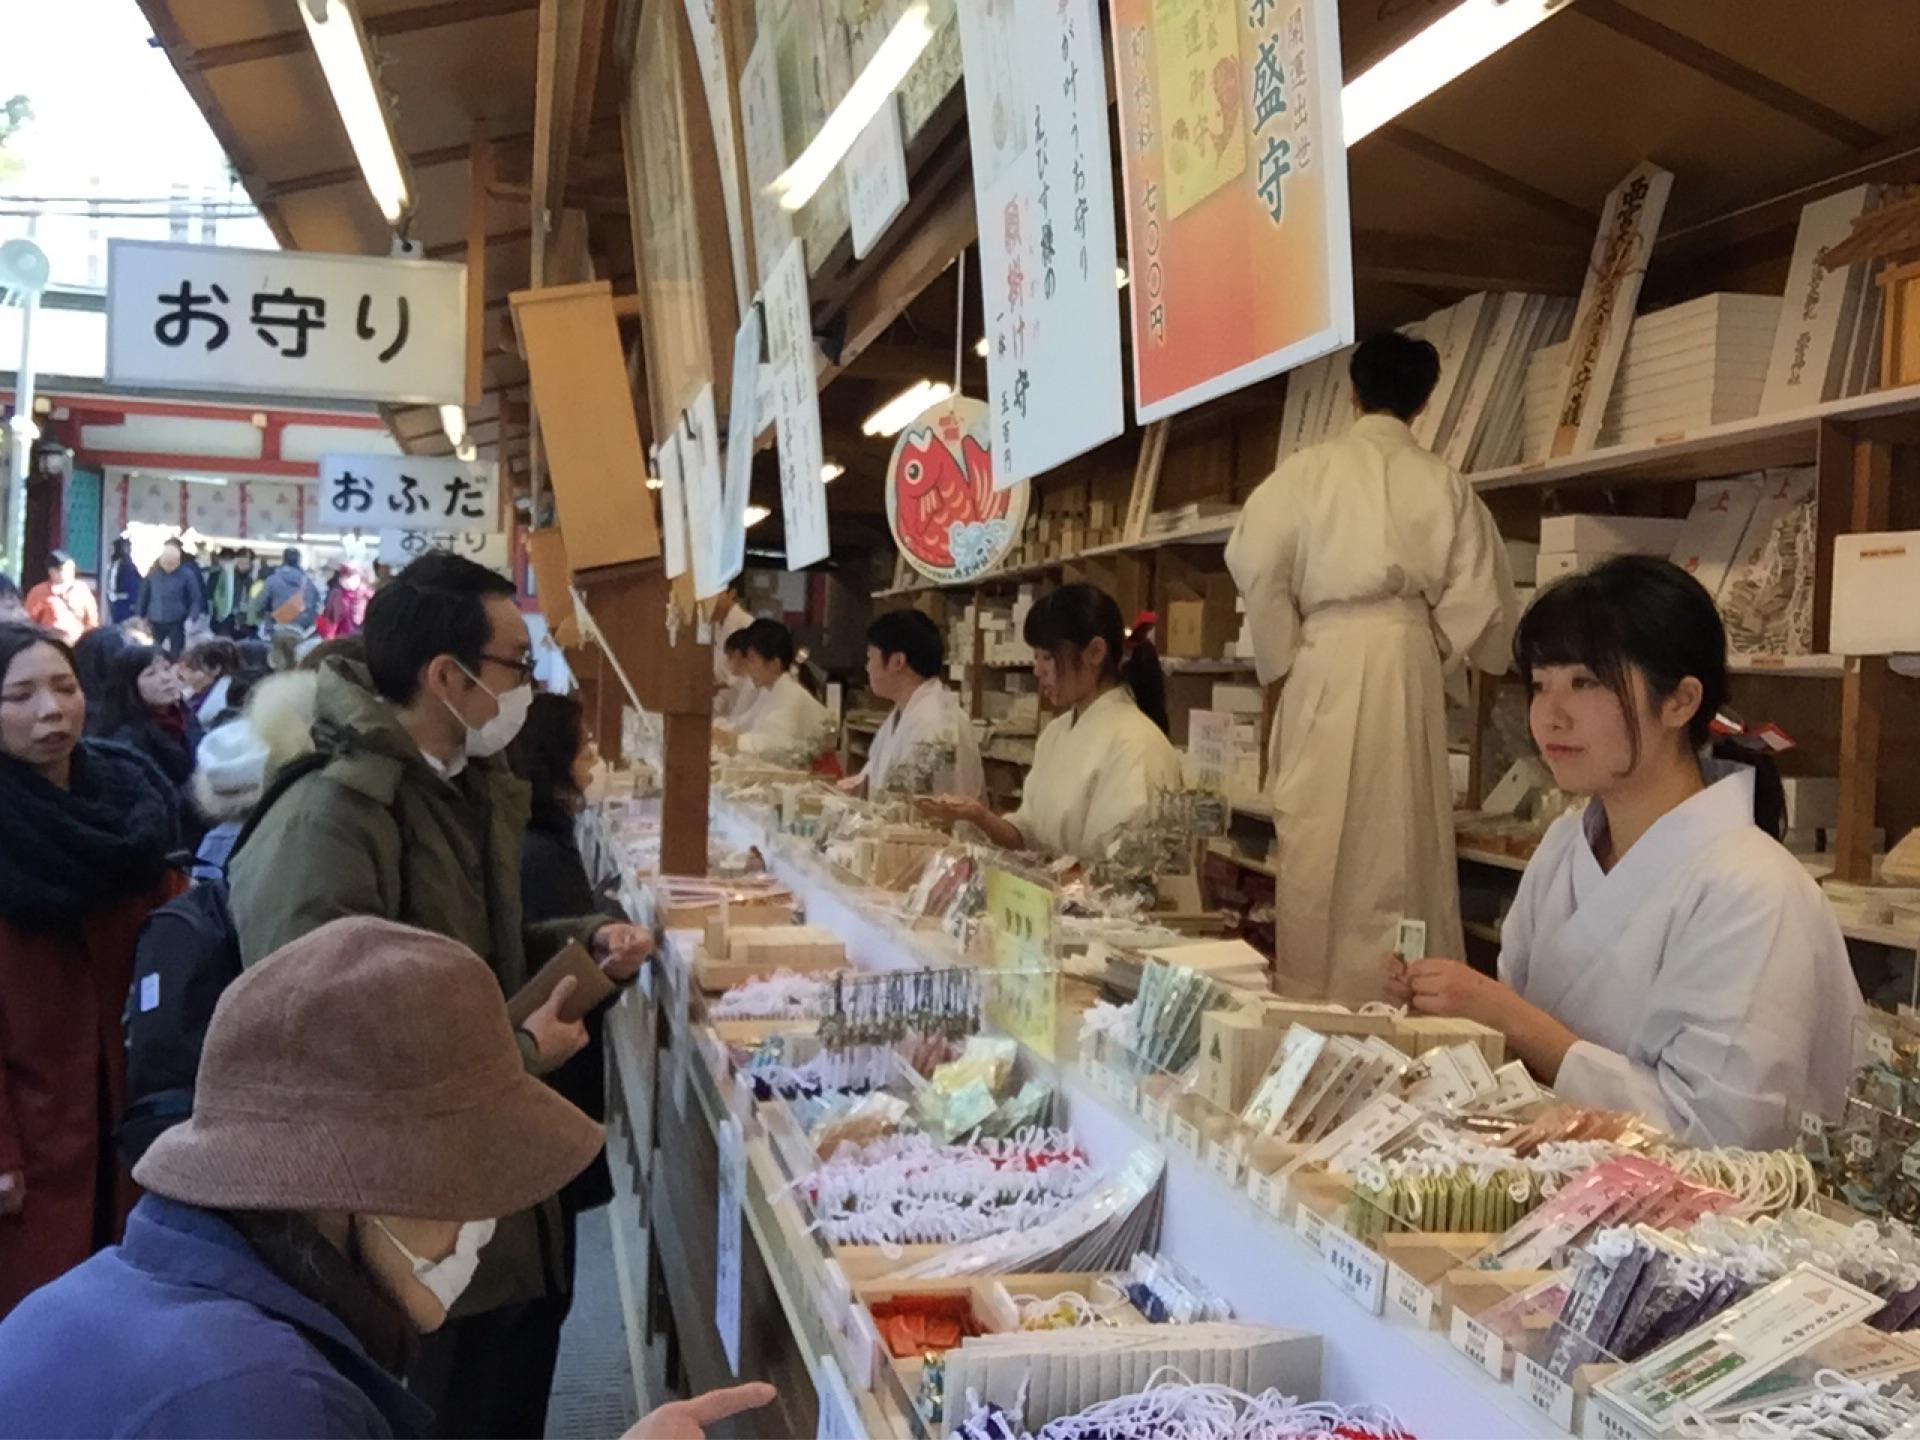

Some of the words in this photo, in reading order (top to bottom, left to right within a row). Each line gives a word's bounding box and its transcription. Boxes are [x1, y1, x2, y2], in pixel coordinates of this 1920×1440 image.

[154, 279, 408, 363] お守り
[331, 470, 488, 518] おふだ
